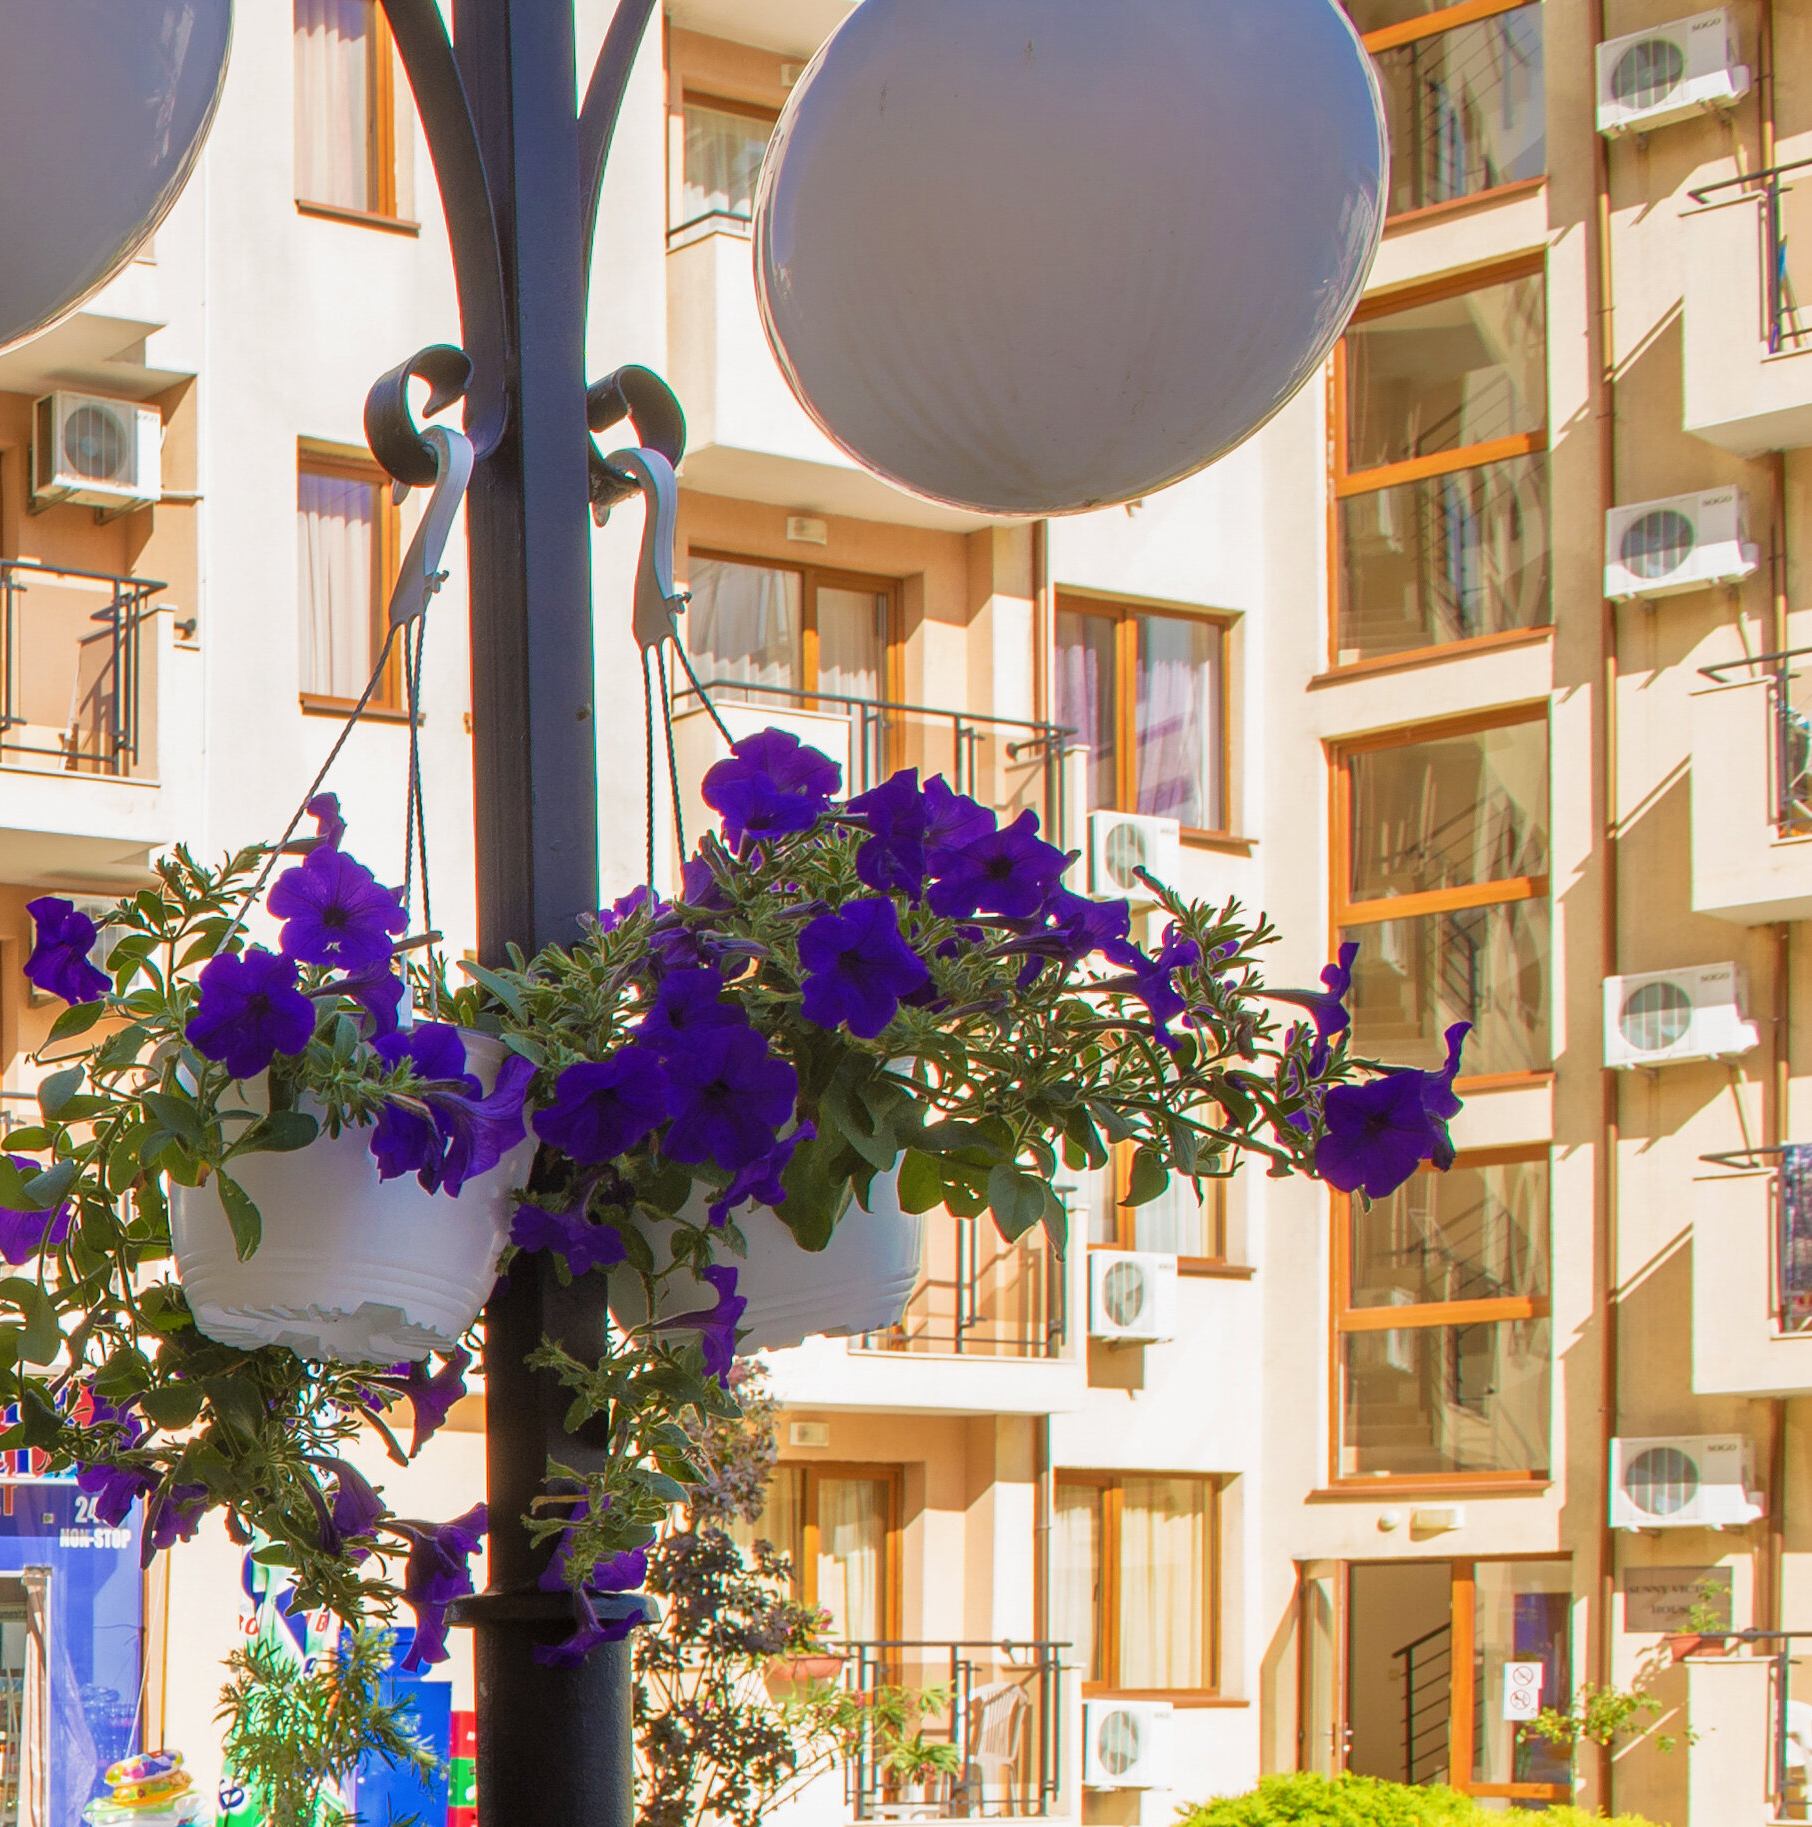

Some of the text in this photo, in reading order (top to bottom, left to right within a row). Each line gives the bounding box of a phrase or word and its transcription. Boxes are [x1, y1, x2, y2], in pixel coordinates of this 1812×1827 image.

[59, 1527, 132, 1549] NON-STOP
[1628, 1585, 1668, 1594] SUNNY
[1651, 1603, 1692, 1615] HOUS
